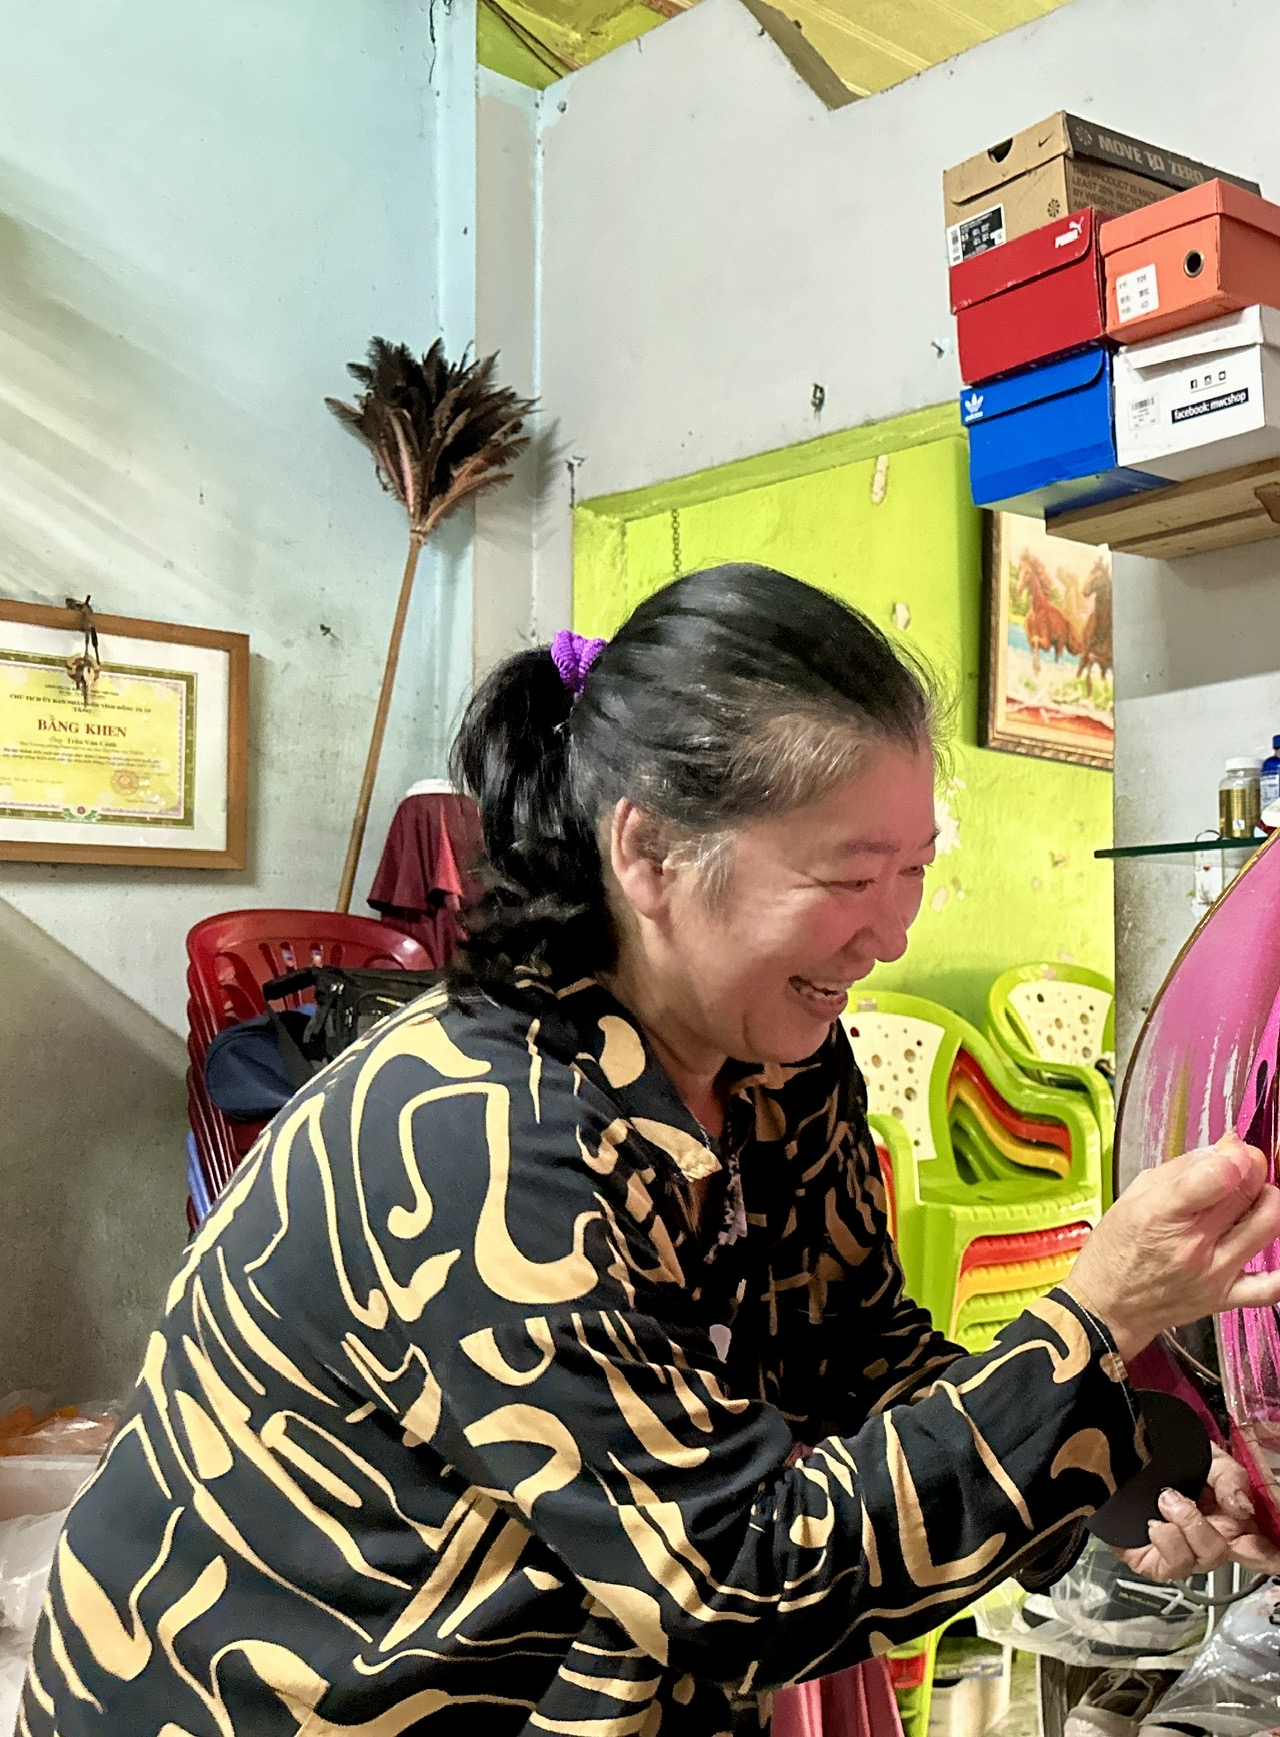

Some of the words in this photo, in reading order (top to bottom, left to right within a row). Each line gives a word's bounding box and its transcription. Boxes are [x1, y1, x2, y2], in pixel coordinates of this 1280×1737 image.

[1098, 134, 1144, 164] MOVE
[1144, 151, 1166, 172] TO
[85, 722, 128, 738] KHEN
